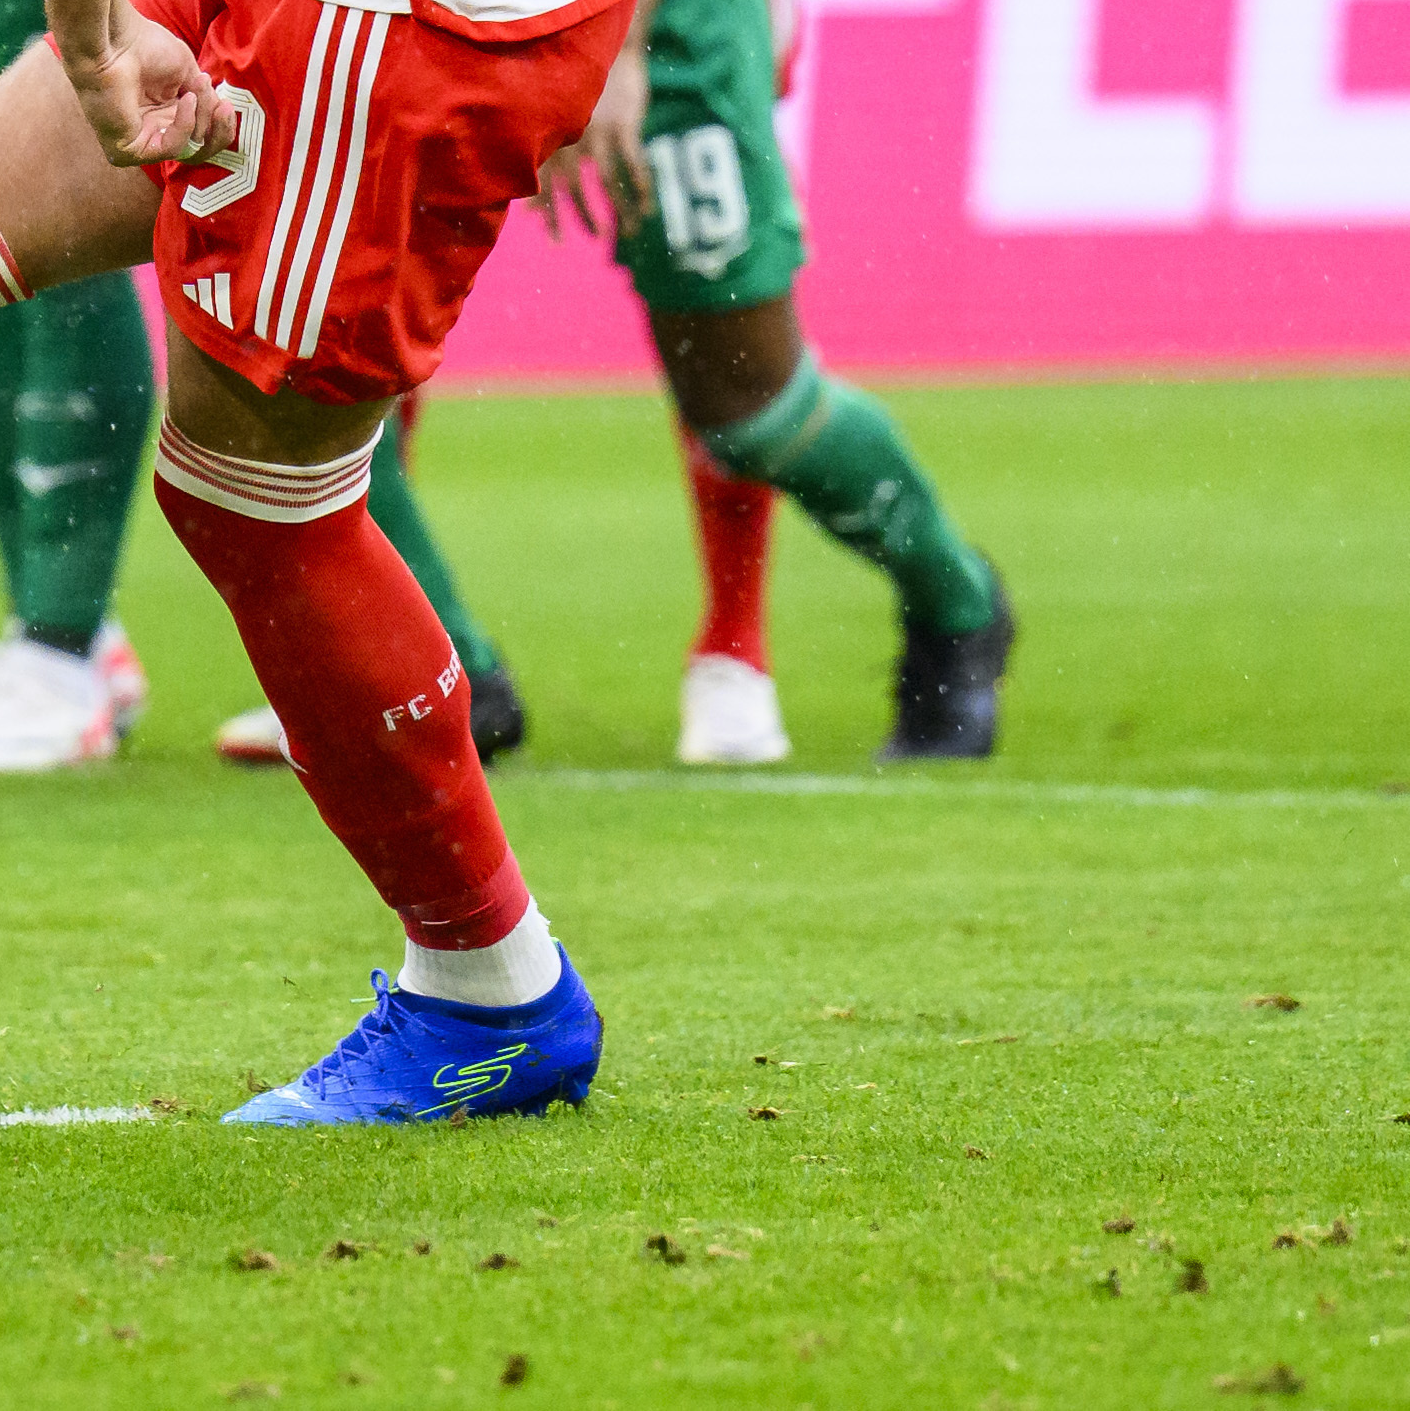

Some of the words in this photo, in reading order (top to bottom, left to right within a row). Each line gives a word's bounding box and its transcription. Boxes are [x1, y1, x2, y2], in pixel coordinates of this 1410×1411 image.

[647, 123, 747, 252] 19
[382, 693, 433, 732] FC
[436, 636, 461, 699] BA
